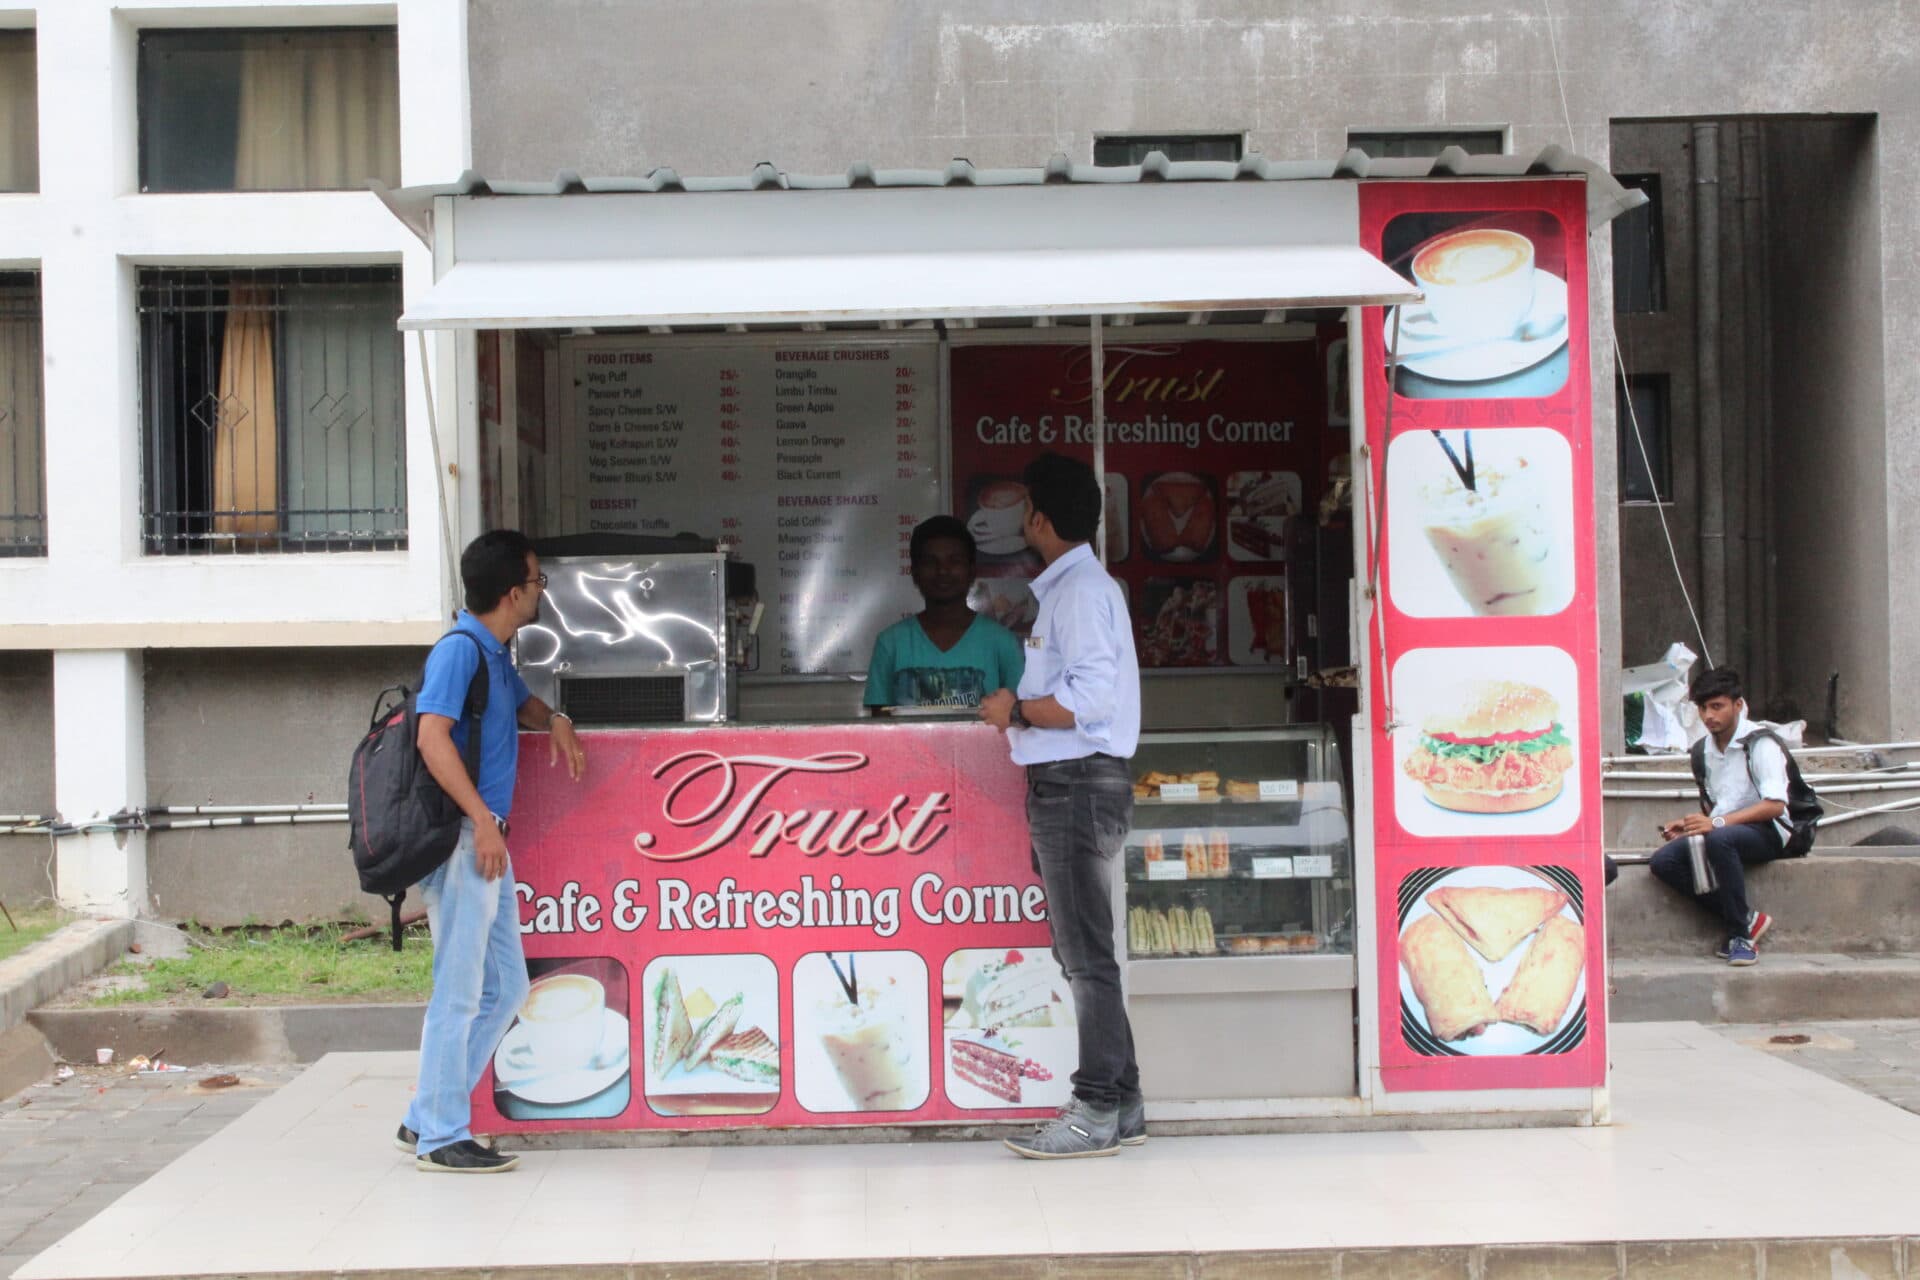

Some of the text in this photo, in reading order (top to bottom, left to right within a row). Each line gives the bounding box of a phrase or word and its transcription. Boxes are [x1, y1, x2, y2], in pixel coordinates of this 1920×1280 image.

[587, 352, 653, 364] FOOD ITEMS
[775, 350, 890, 362] BEVERAGE CRUSHERS
[587, 370, 627, 384] Veg Puff
[1050, 344, 1225, 404] Trust
[623, 387, 643, 399] Puff
[775, 401, 834, 414] Green Apple
[976, 415, 1032, 445] Cafe
[1038, 415, 1057, 444] &
[1206, 413, 1294, 444] Corner
[590, 499, 638, 510] DESSERT
[778, 495, 879, 507] BEVERAGE SHAKES
[590, 519, 638, 530] Chocolate
[778, 516, 800, 528] Cold
[635, 749, 952, 862] Trust
[612, 879, 648, 936] &
[658, 873, 900, 937] Refreshing
[910, 871, 1050, 925] Corne
